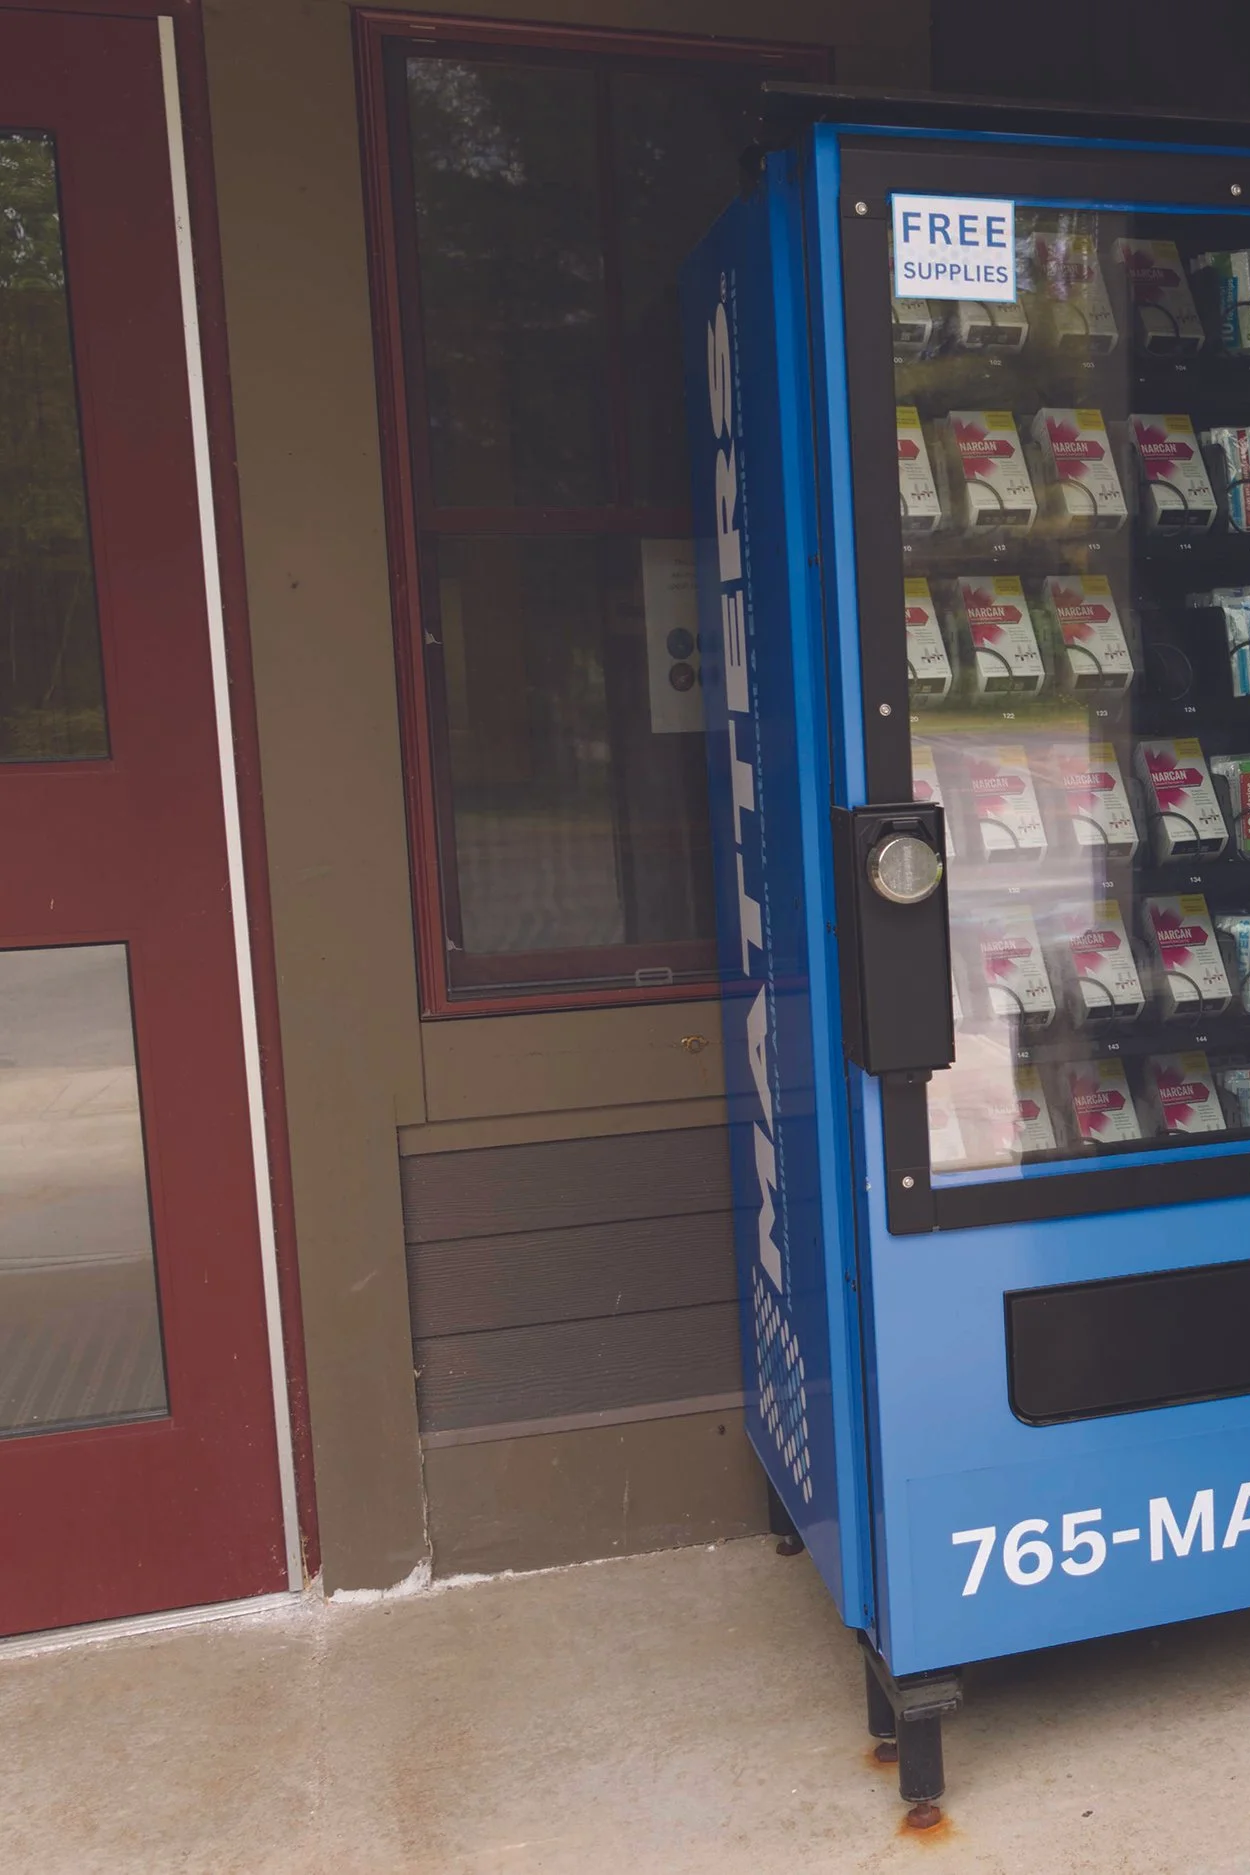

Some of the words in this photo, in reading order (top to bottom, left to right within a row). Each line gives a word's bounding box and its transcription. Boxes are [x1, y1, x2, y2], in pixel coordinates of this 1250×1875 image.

[902, 211, 1007, 248] FREE
[903, 261, 1008, 284] SUPPLIES
[729, 267, 743, 436] Referrals
[960, 441, 998, 453] NARCAN
[1052, 441, 1088, 453] NARCAN
[1140, 443, 1177, 454] NARCAN
[736, 449, 754, 636] Electronic
[993, 544, 1006, 552] 112
[968, 606, 1005, 618] NARCAN
[1058, 606, 1094, 617] NARCAN
[748, 682, 768, 868] Treatment
[1063, 773, 1099, 787] NARCAN
[1152, 769, 1188, 783] NARCAN
[972, 777, 1009, 790] NARCAN
[1069, 932, 1106, 947] NARCAN
[1157, 927, 1193, 941] NARCAN
[980, 940, 1017, 953] NARCAN
[761, 881, 779, 1055] Addiction
[1108, 1043, 1120, 1051] 143
[1017, 1051, 1029, 1059] 142
[1159, 1085, 1195, 1099] NARCAN
[1074, 1092, 1110, 1107] NARCAN
[777, 1124, 795, 1314] Medication
